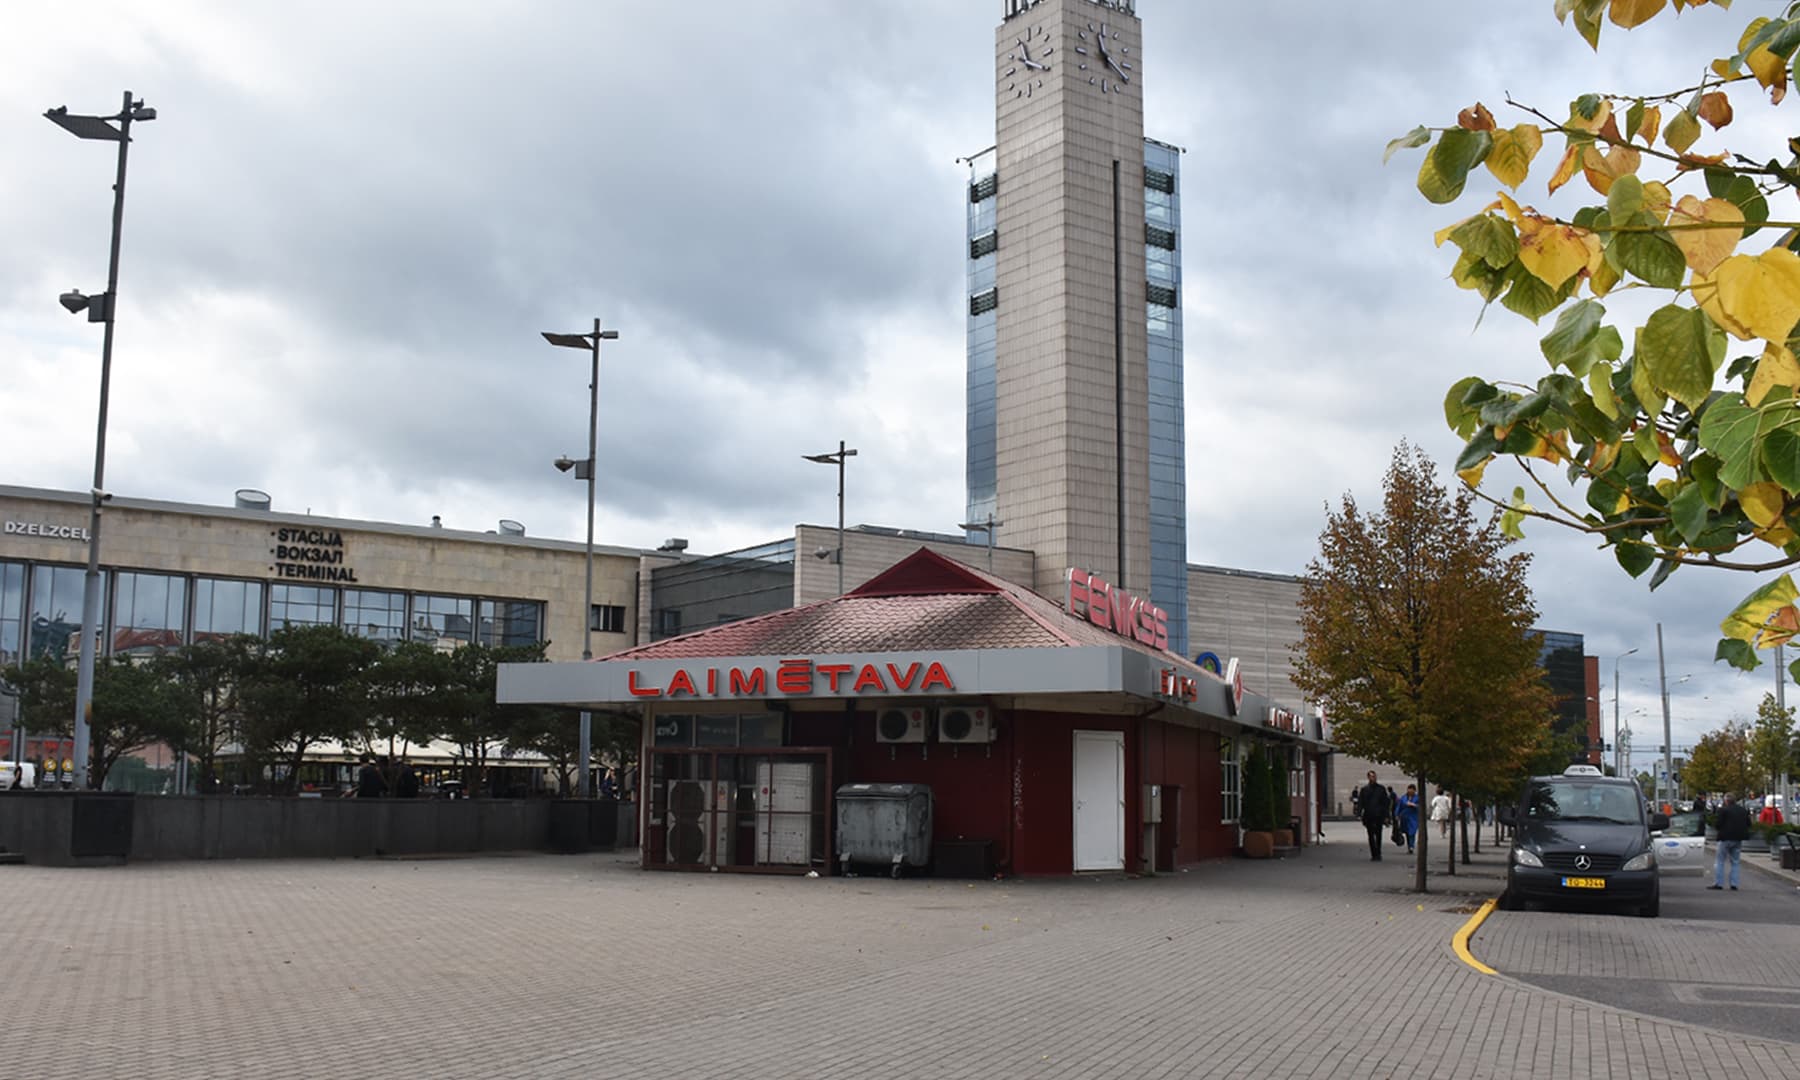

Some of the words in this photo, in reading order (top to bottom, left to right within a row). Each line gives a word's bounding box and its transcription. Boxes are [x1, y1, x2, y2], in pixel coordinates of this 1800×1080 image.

[4, 520, 101, 543] DZELZCEĻ
[278, 527, 343, 547] STACIJA
[276, 545, 343, 564] ВОКЗАЛ
[275, 562, 358, 582] TERMINAL
[628, 658, 955, 696] LAIMĒTAVA
